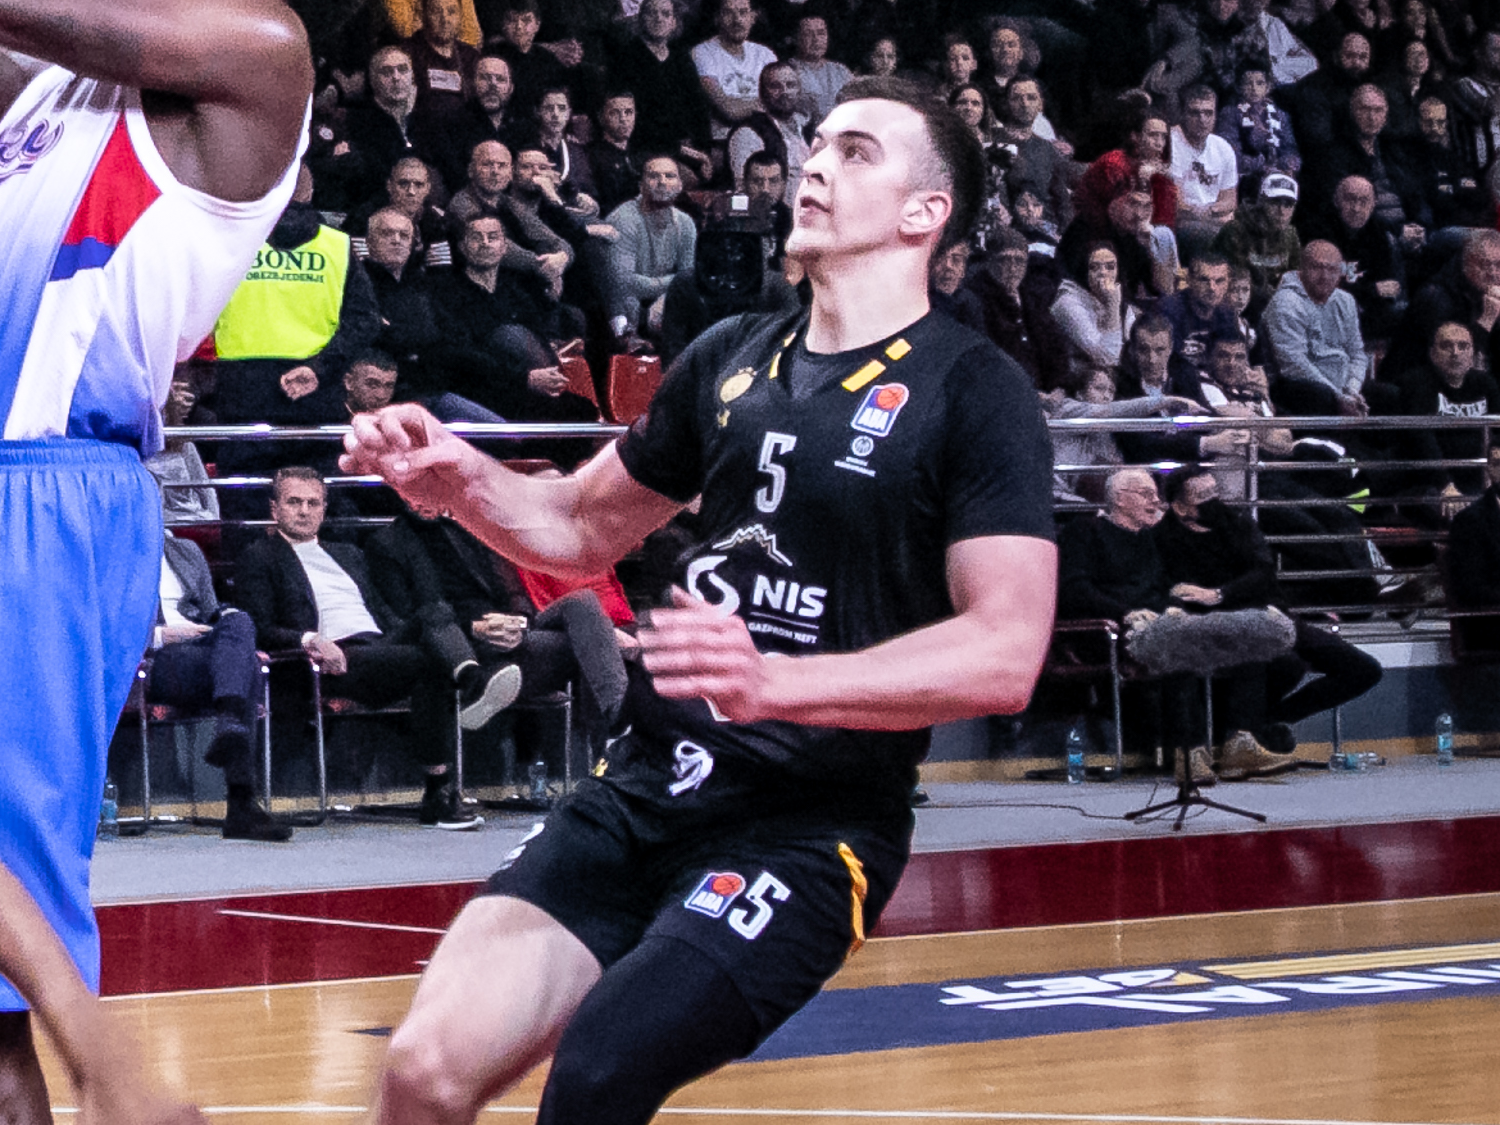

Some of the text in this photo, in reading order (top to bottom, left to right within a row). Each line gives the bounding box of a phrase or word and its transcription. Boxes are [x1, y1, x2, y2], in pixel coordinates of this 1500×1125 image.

[755, 431, 797, 513] 5
[752, 575, 827, 617] NIS
[728, 870, 792, 940] 5
